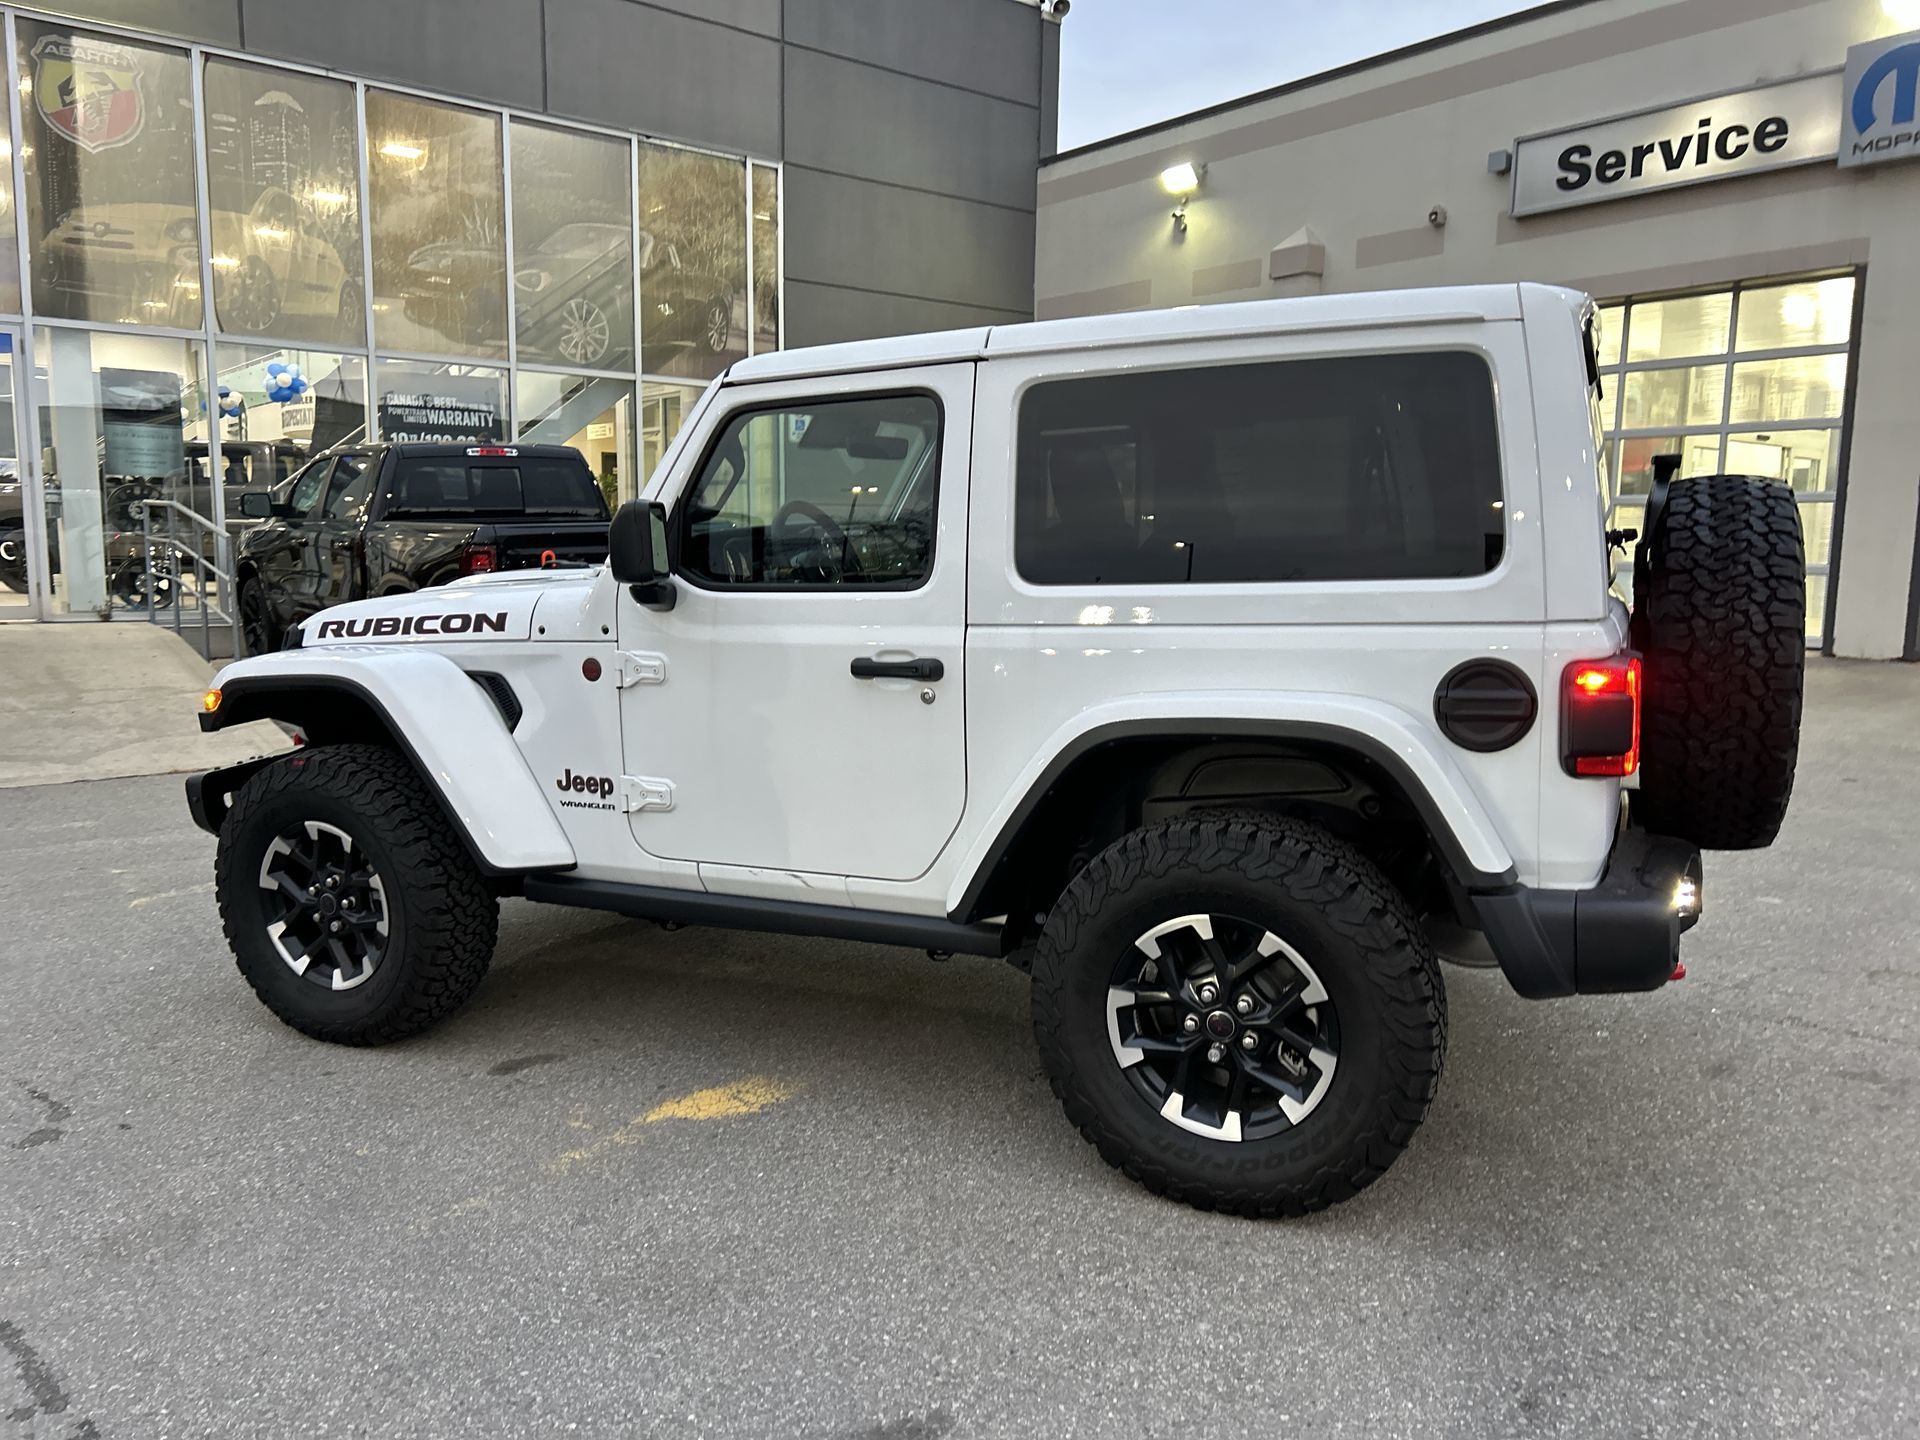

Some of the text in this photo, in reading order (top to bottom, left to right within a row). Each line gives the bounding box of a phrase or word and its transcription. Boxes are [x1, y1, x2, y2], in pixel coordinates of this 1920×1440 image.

[1556, 117, 1789, 191] Service
[386, 393, 433, 408] CANADA'S
[433, 396, 456, 409] BEST
[427, 409, 494, 428] WARRANTY
[317, 612, 509, 639] RUBICON
[556, 768, 614, 800] Jeep
[560, 800, 615, 811] WRANGLER
